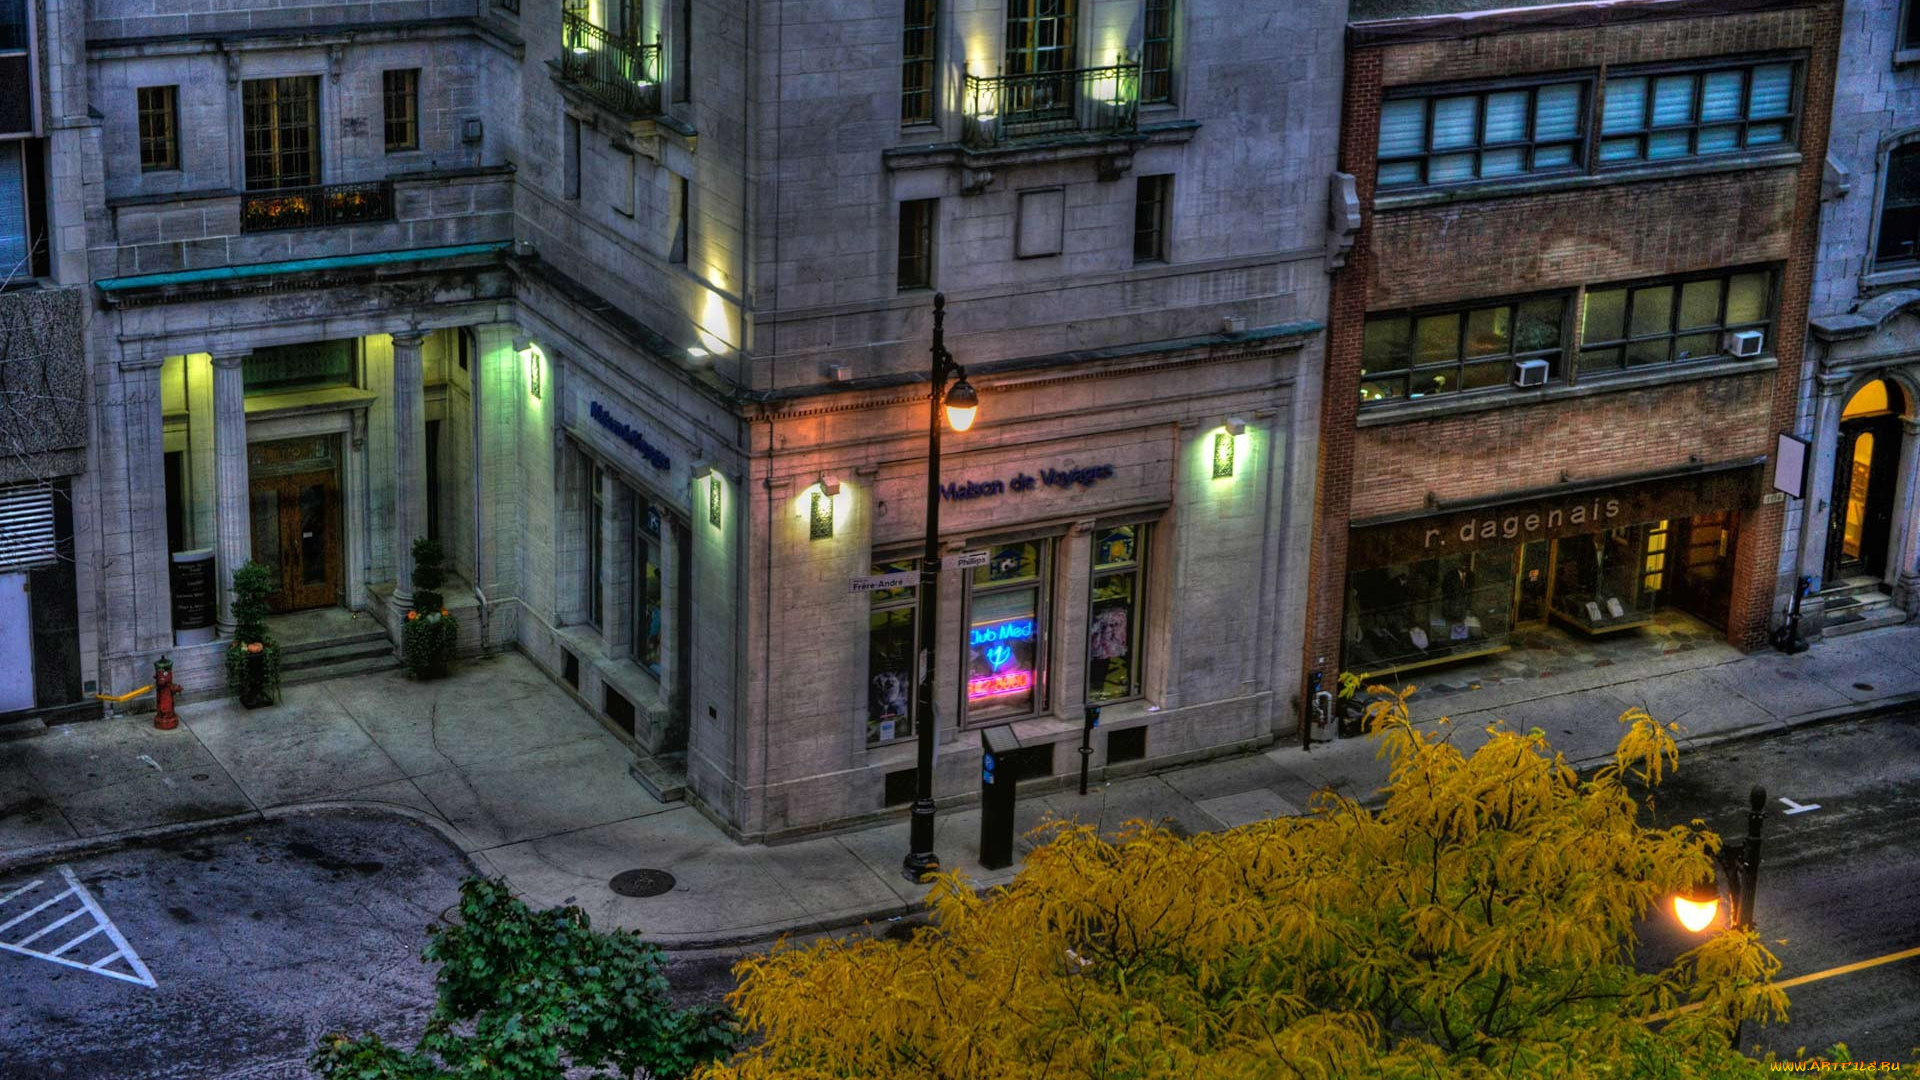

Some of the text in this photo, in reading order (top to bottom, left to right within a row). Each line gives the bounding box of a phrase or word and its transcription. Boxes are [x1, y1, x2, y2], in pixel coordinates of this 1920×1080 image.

[939, 465, 1115, 502] Maison de Voyages
[1425, 498, 1620, 548] r. dagenais
[999, 621, 1032, 640] Med
